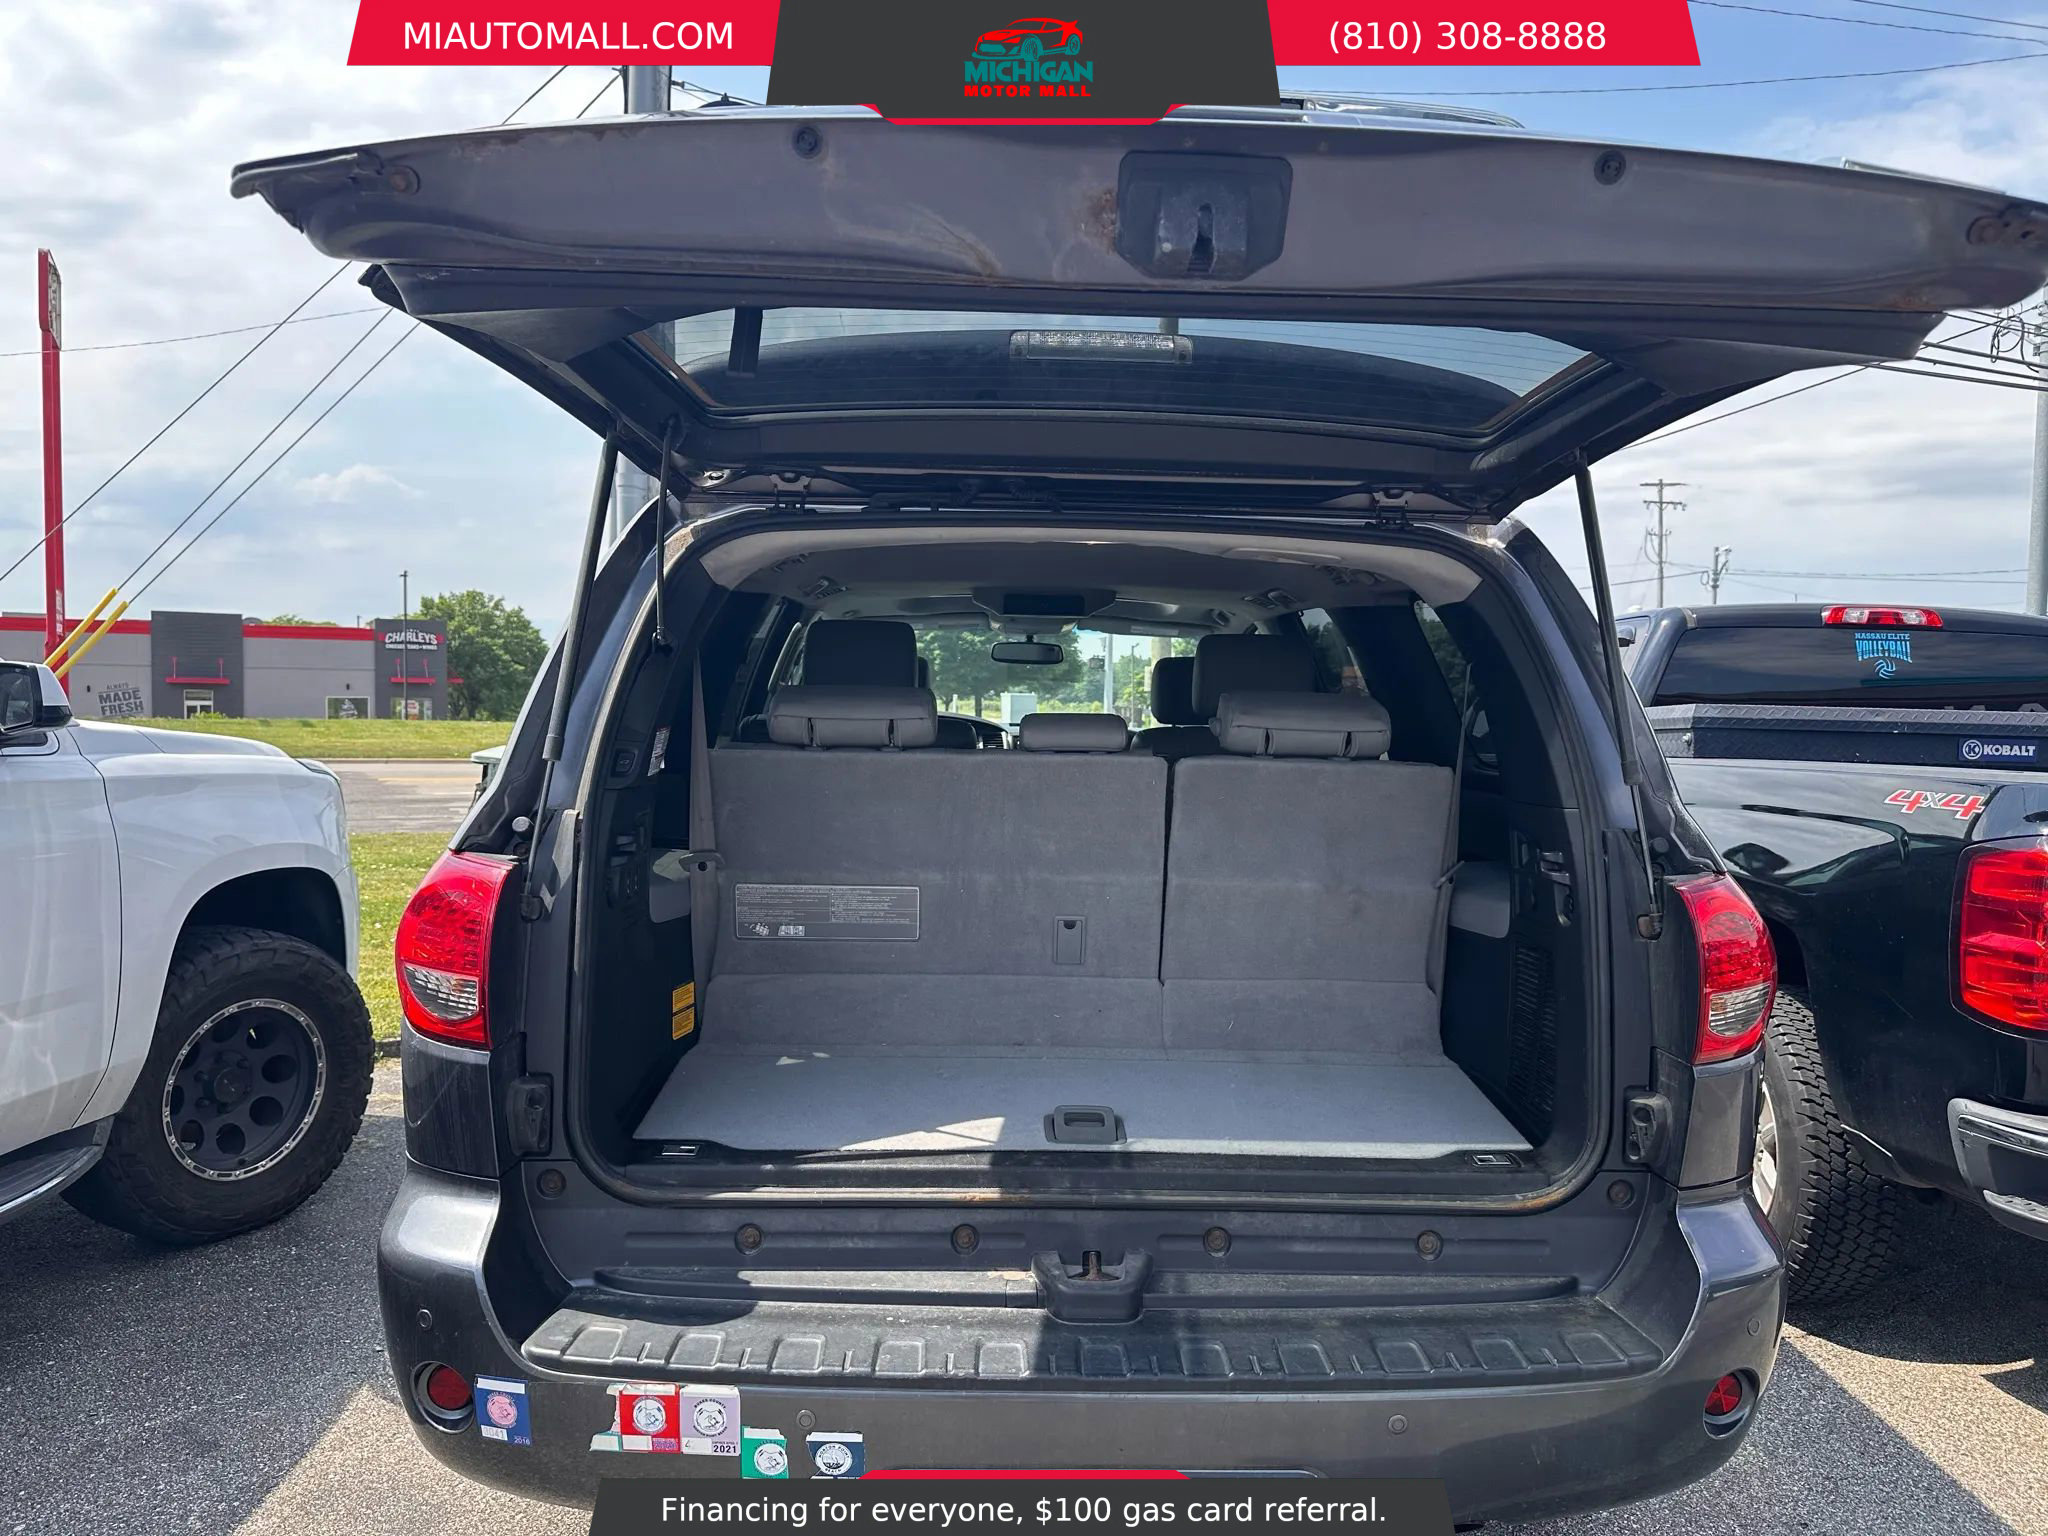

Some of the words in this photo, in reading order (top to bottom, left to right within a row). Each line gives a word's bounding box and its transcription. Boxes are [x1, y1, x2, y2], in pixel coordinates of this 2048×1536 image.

[385, 631, 437, 644] CHARLEYS
[1855, 640, 1913, 663] VOLLEYBALL
[98, 689, 141, 705] MADE
[100, 700, 144, 715] FRESH
[1983, 744, 2036, 756] KOBALT
[713, 1444, 737, 1454] 2021
